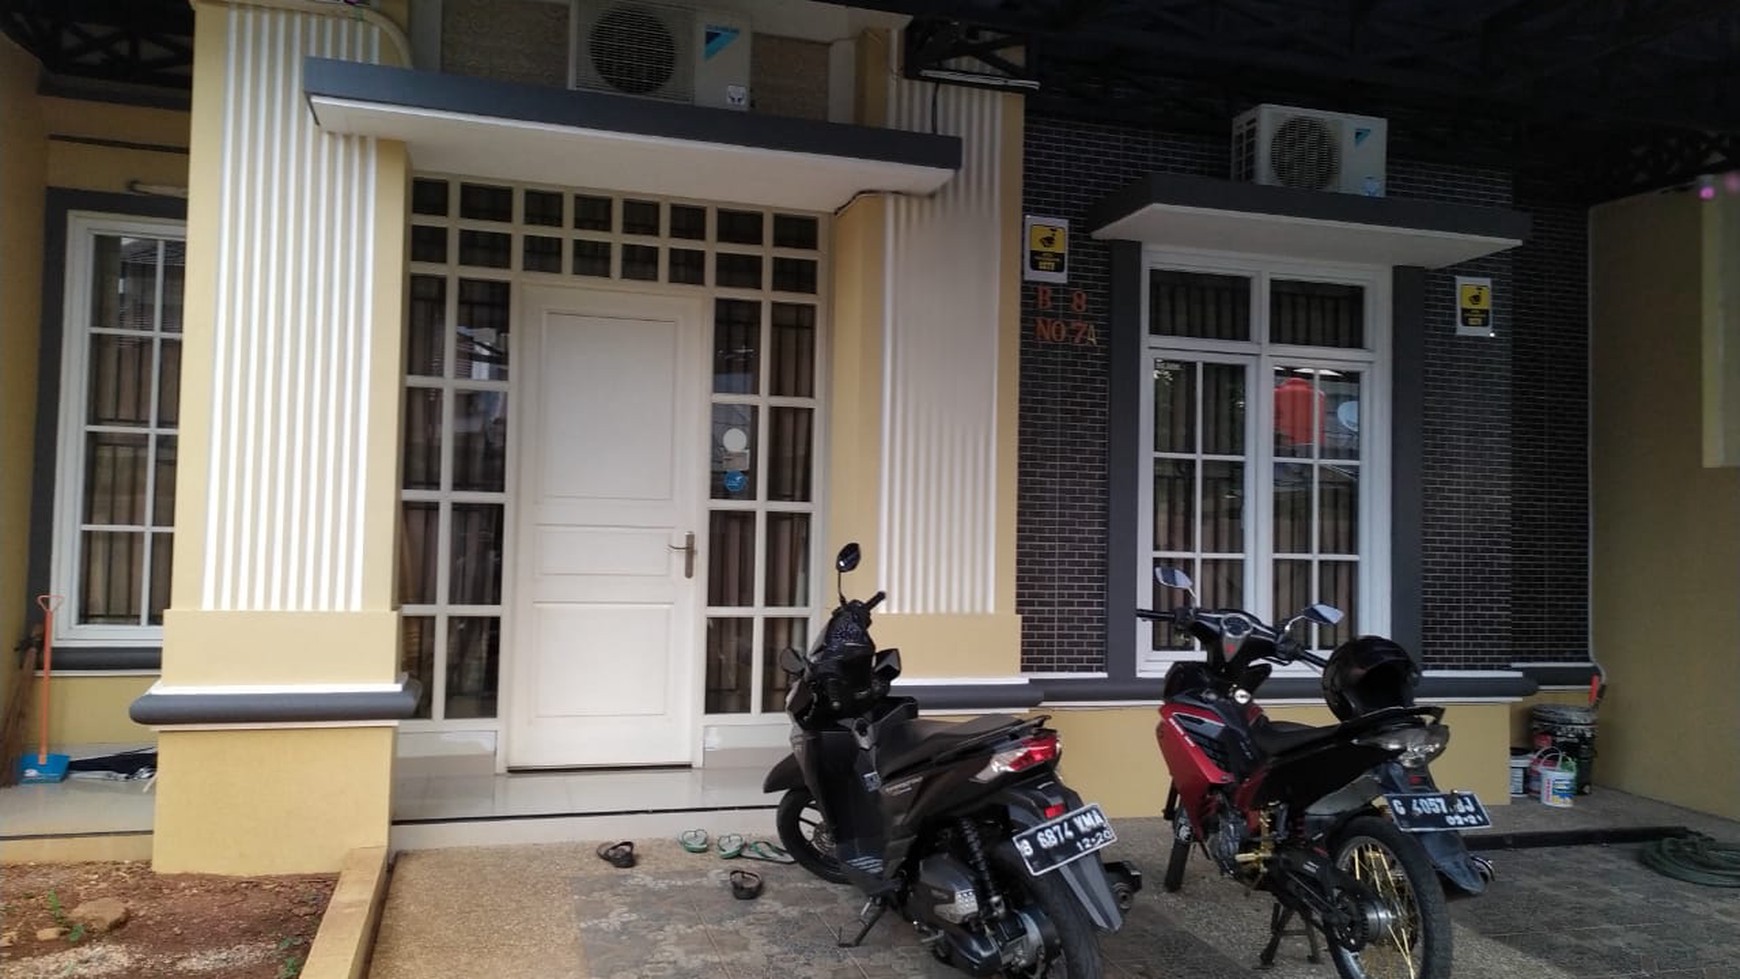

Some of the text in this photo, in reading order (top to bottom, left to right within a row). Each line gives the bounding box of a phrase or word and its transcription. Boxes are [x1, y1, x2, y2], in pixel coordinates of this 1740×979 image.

[1071, 290, 1087, 313] 8
[1411, 797, 1448, 815] 4057
[1020, 839, 1033, 856] B
[1037, 822, 1074, 849] 6874
